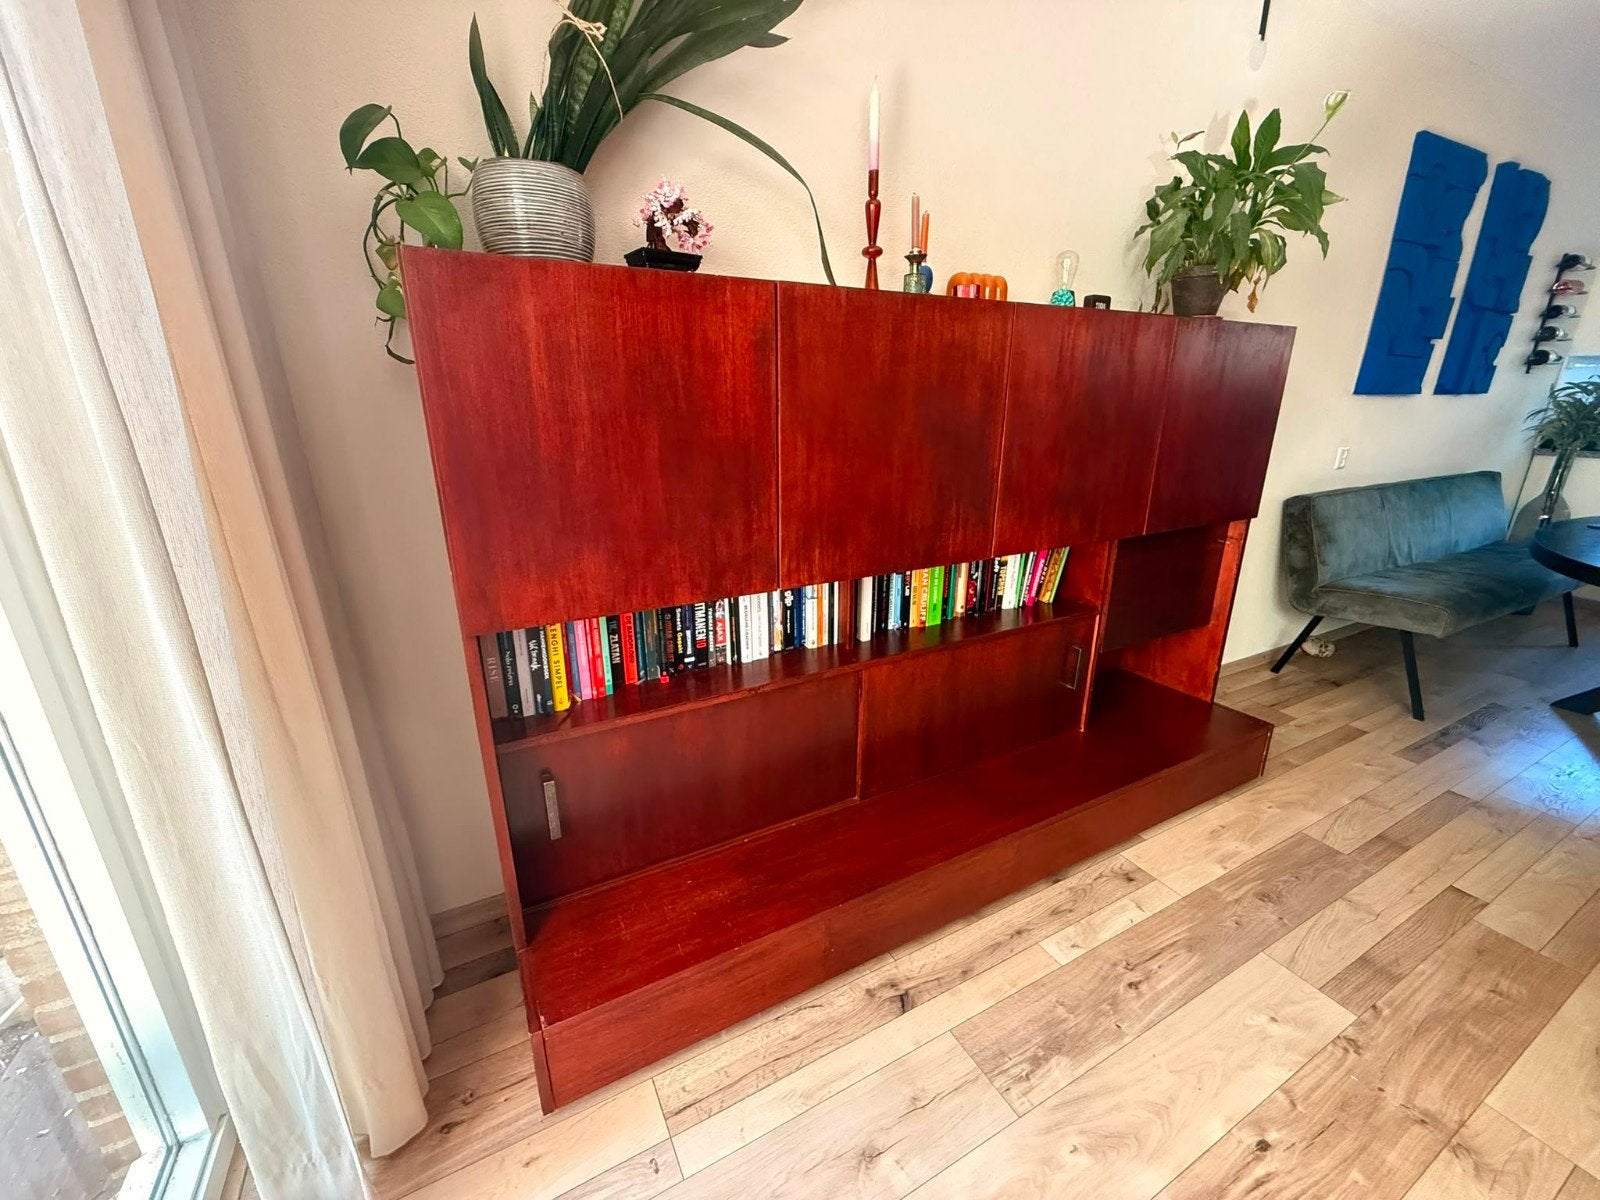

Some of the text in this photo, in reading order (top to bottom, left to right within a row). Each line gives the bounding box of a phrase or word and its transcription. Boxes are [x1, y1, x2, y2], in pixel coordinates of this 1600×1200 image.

[676, 632, 684, 654] Gepakt
[716, 622, 724, 644] AJAX
[610, 634, 620, 664] ZLATAN
[487, 657, 499, 682] RISE
[553, 659, 563, 690] SIMPEL
